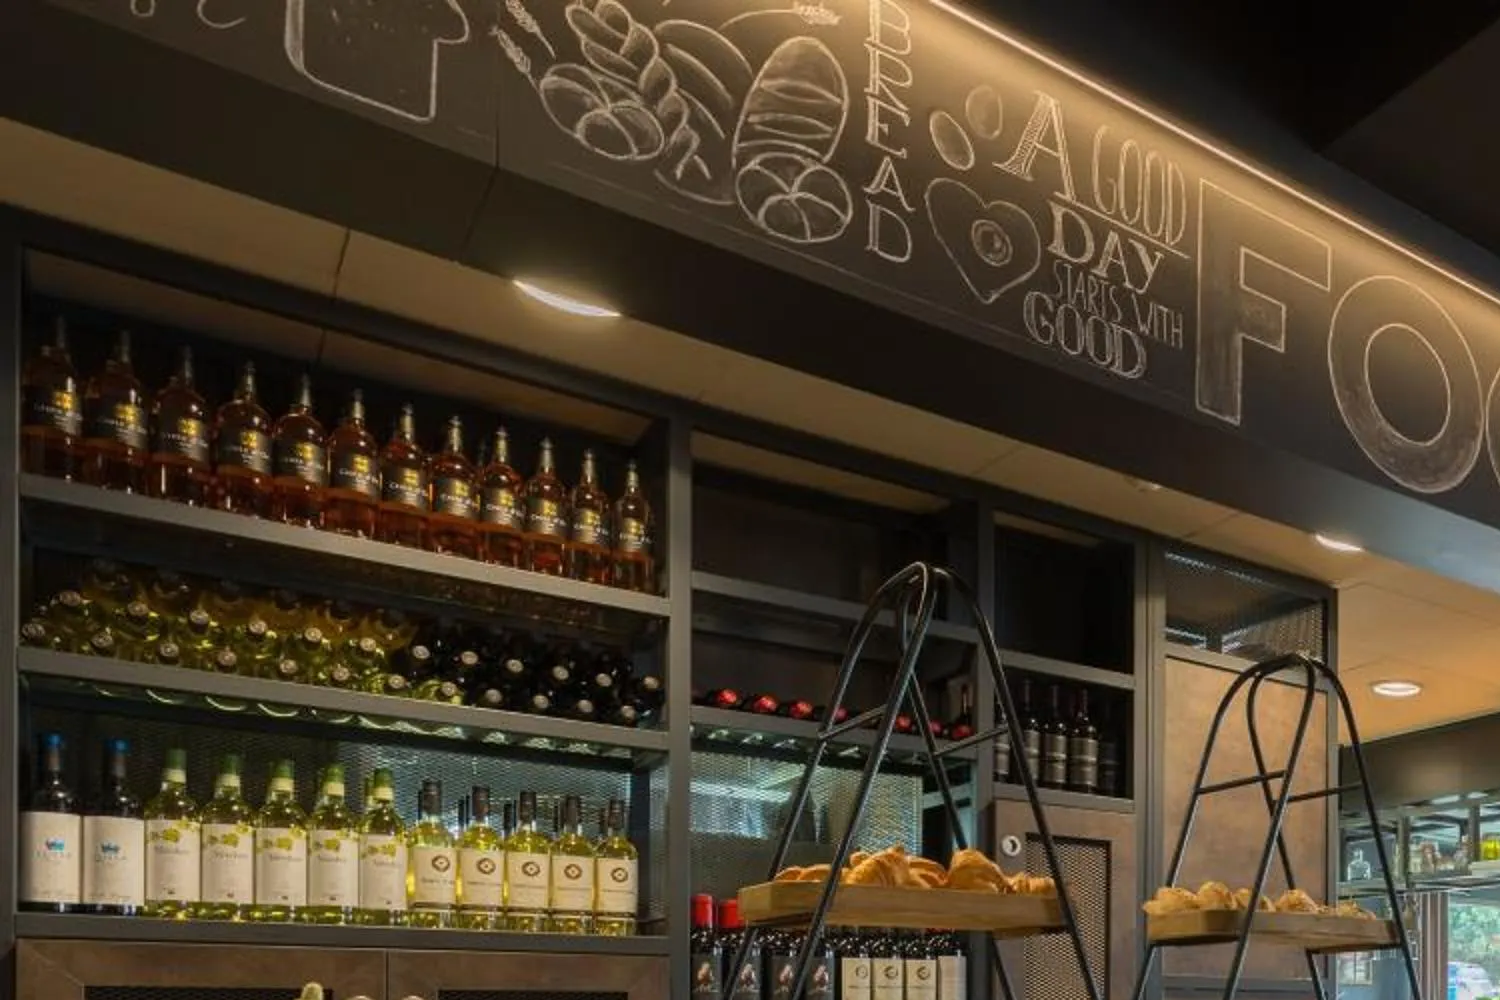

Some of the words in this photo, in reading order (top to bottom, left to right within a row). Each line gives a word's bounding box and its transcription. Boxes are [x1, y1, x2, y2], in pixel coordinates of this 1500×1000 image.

[864, 0, 915, 262] BREAD
[992, 90, 1076, 205] A
[1092, 125, 1187, 246] GOOD
[1047, 200, 1164, 295] DAY
[1022, 291, 1147, 379] GOOD
[1053, 260, 1123, 324] STARTS
[1130, 293, 1184, 349] WITH
